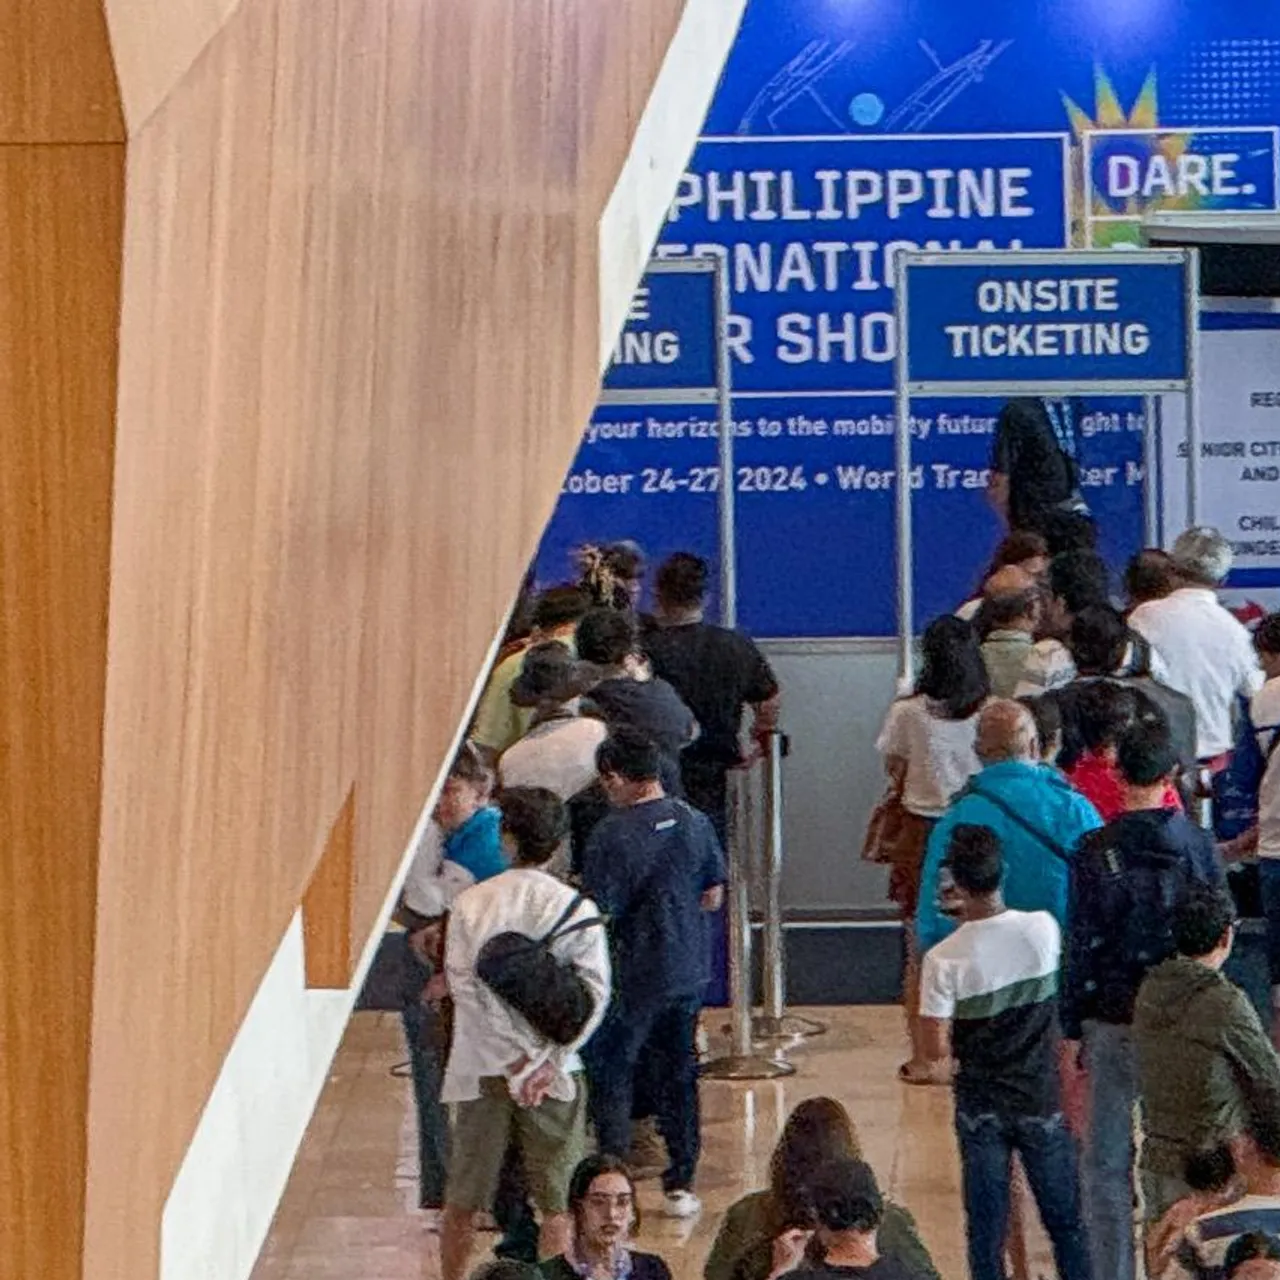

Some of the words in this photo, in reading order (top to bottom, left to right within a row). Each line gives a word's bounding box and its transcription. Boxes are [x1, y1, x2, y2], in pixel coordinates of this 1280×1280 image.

[1107, 153, 1258, 197] DARE.
[668, 167, 1035, 222] PHILIPPINE
[977, 278, 1120, 313] ONSITE
[944, 323, 1151, 358] TICKETING
[756, 417, 783, 438] to
[787, 414, 830, 438] the
[937, 412, 998, 436] futur
[1177, 440, 1245, 458] SNIOR
[737, 466, 808, 492] 2024
[835, 463, 925, 491] Word
[1240, 466, 1280, 482] AND
